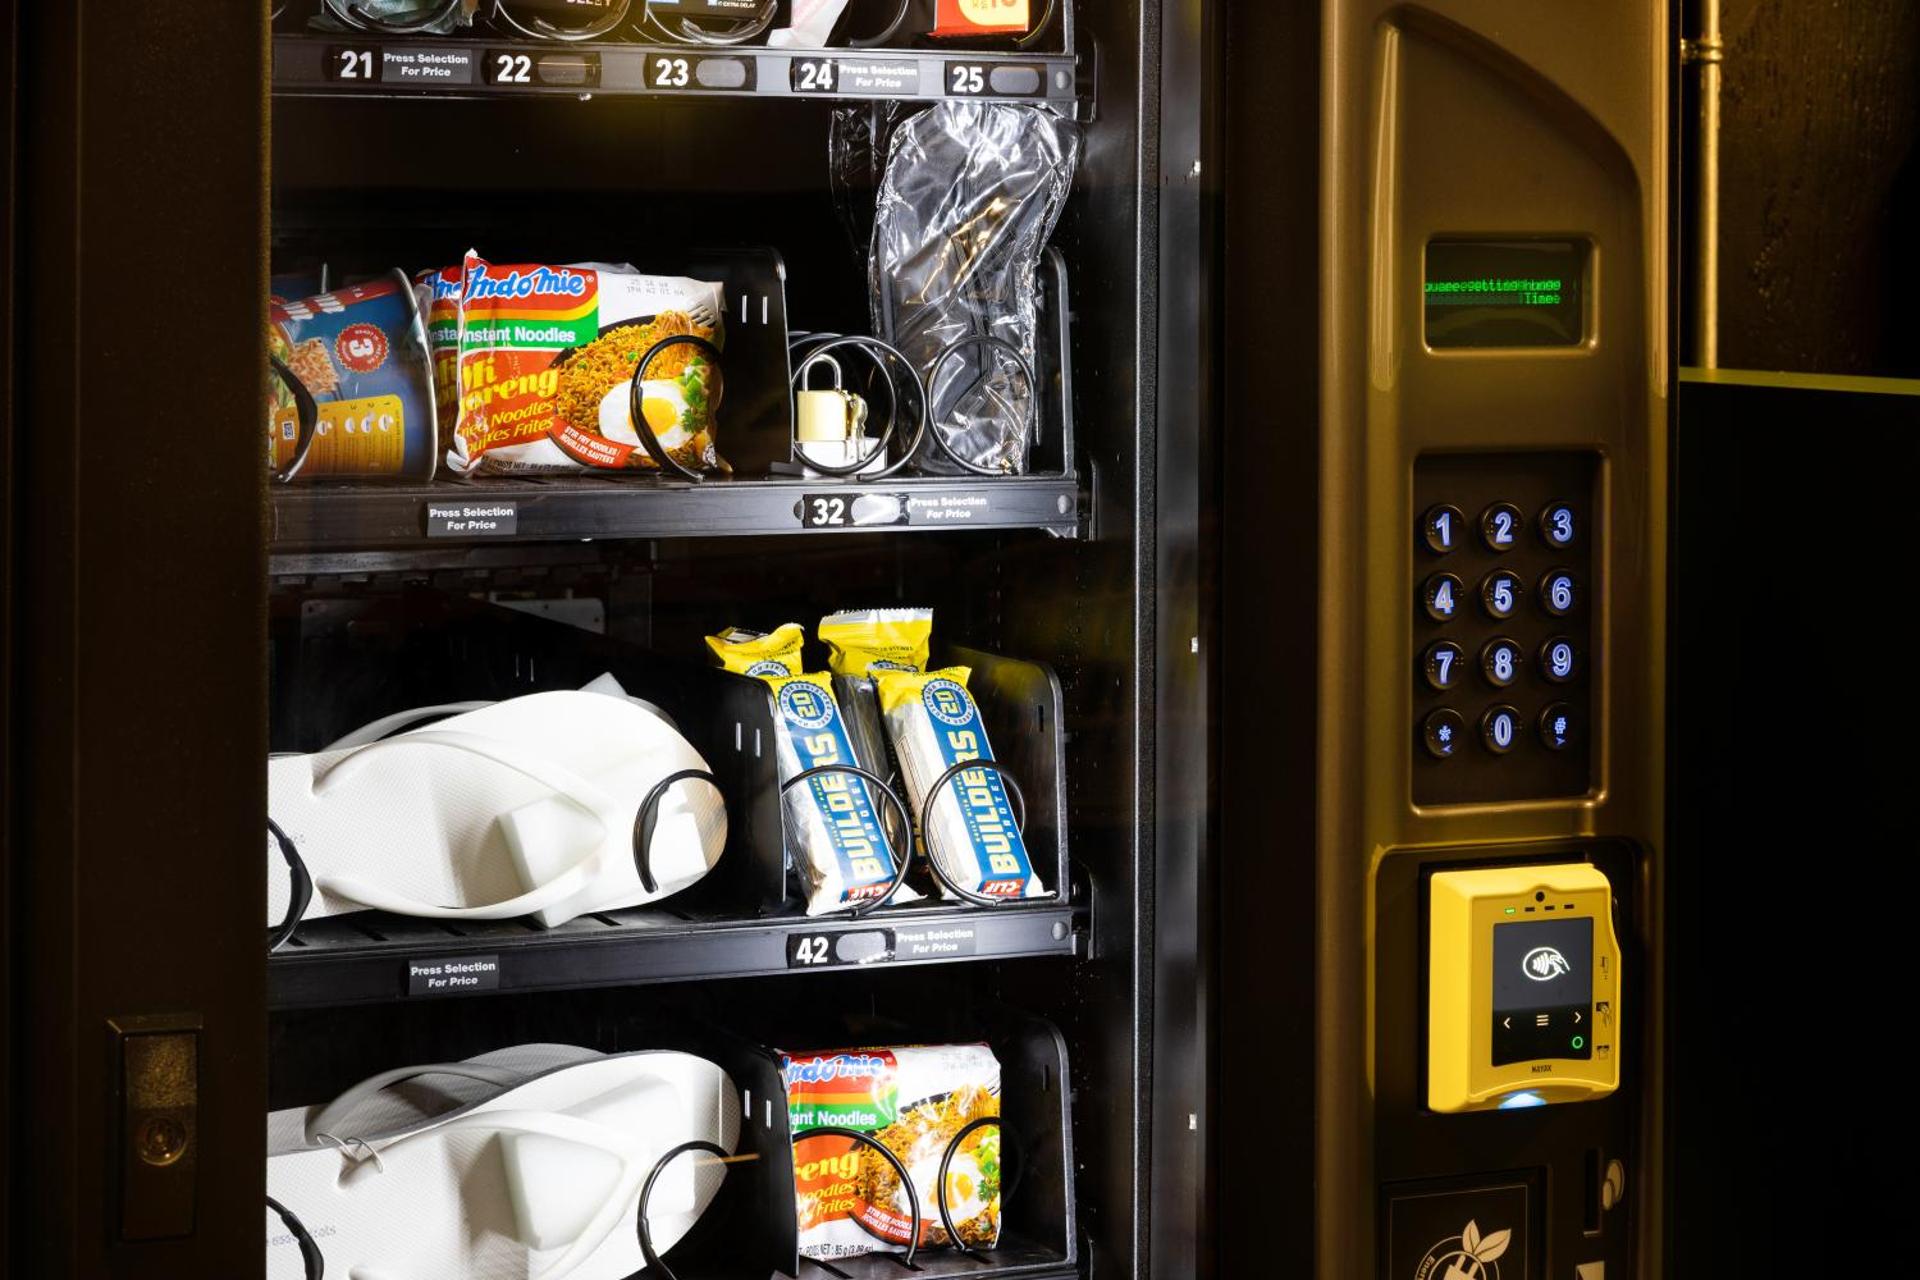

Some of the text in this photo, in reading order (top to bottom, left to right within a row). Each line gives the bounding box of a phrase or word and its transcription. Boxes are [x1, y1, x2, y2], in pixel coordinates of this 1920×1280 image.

[340, 51, 372, 79] 21
[383, 53, 469, 65] Press Selection
[401, 66, 451, 77] For Price
[497, 55, 531, 82] 22
[656, 59, 689, 86] 23
[839, 65, 917, 76] Press Selection
[800, 63, 833, 90] 24
[855, 78, 902, 88] For Price
[952, 66, 984, 93] 25
[464, 265, 585, 299] Indomie
[515, 326, 576, 343] Noodles
[461, 368, 559, 412] oreng
[490, 400, 554, 427] Noodles
[513, 417, 554, 437] Frites
[429, 506, 514, 518] Press Selection
[812, 498, 845, 526] 32
[911, 496, 987, 507] Press Selection
[926, 509, 971, 519] For Price
[447, 520, 497, 530] For Price
[1435, 512, 1450, 546] 1
[1494, 511, 1513, 544] 2
[1552, 508, 1573, 542] 3
[1434, 580, 1454, 615] 4
[1494, 579, 1513, 613] 5
[1551, 576, 1572, 610] 6
[1435, 651, 1454, 684] 7
[1494, 647, 1513, 681] 8
[1552, 643, 1572, 677] 9
[934, 690, 959, 714] 20
[1494, 713, 1512, 747] 0
[848, 778, 878, 842] PROTEI
[985, 767, 1016, 839] PROTEI
[986, 880, 1019, 894] CLIF
[897, 929, 973, 943] Press Selection
[912, 943, 958, 954] For Price
[796, 936, 829, 965] 42
[411, 962, 496, 976] Press Selection
[428, 976, 479, 988] For Price
[817, 1110, 877, 1126] Noodles
[804, 1181, 856, 1199] oodles
[816, 1197, 857, 1217] Frites
